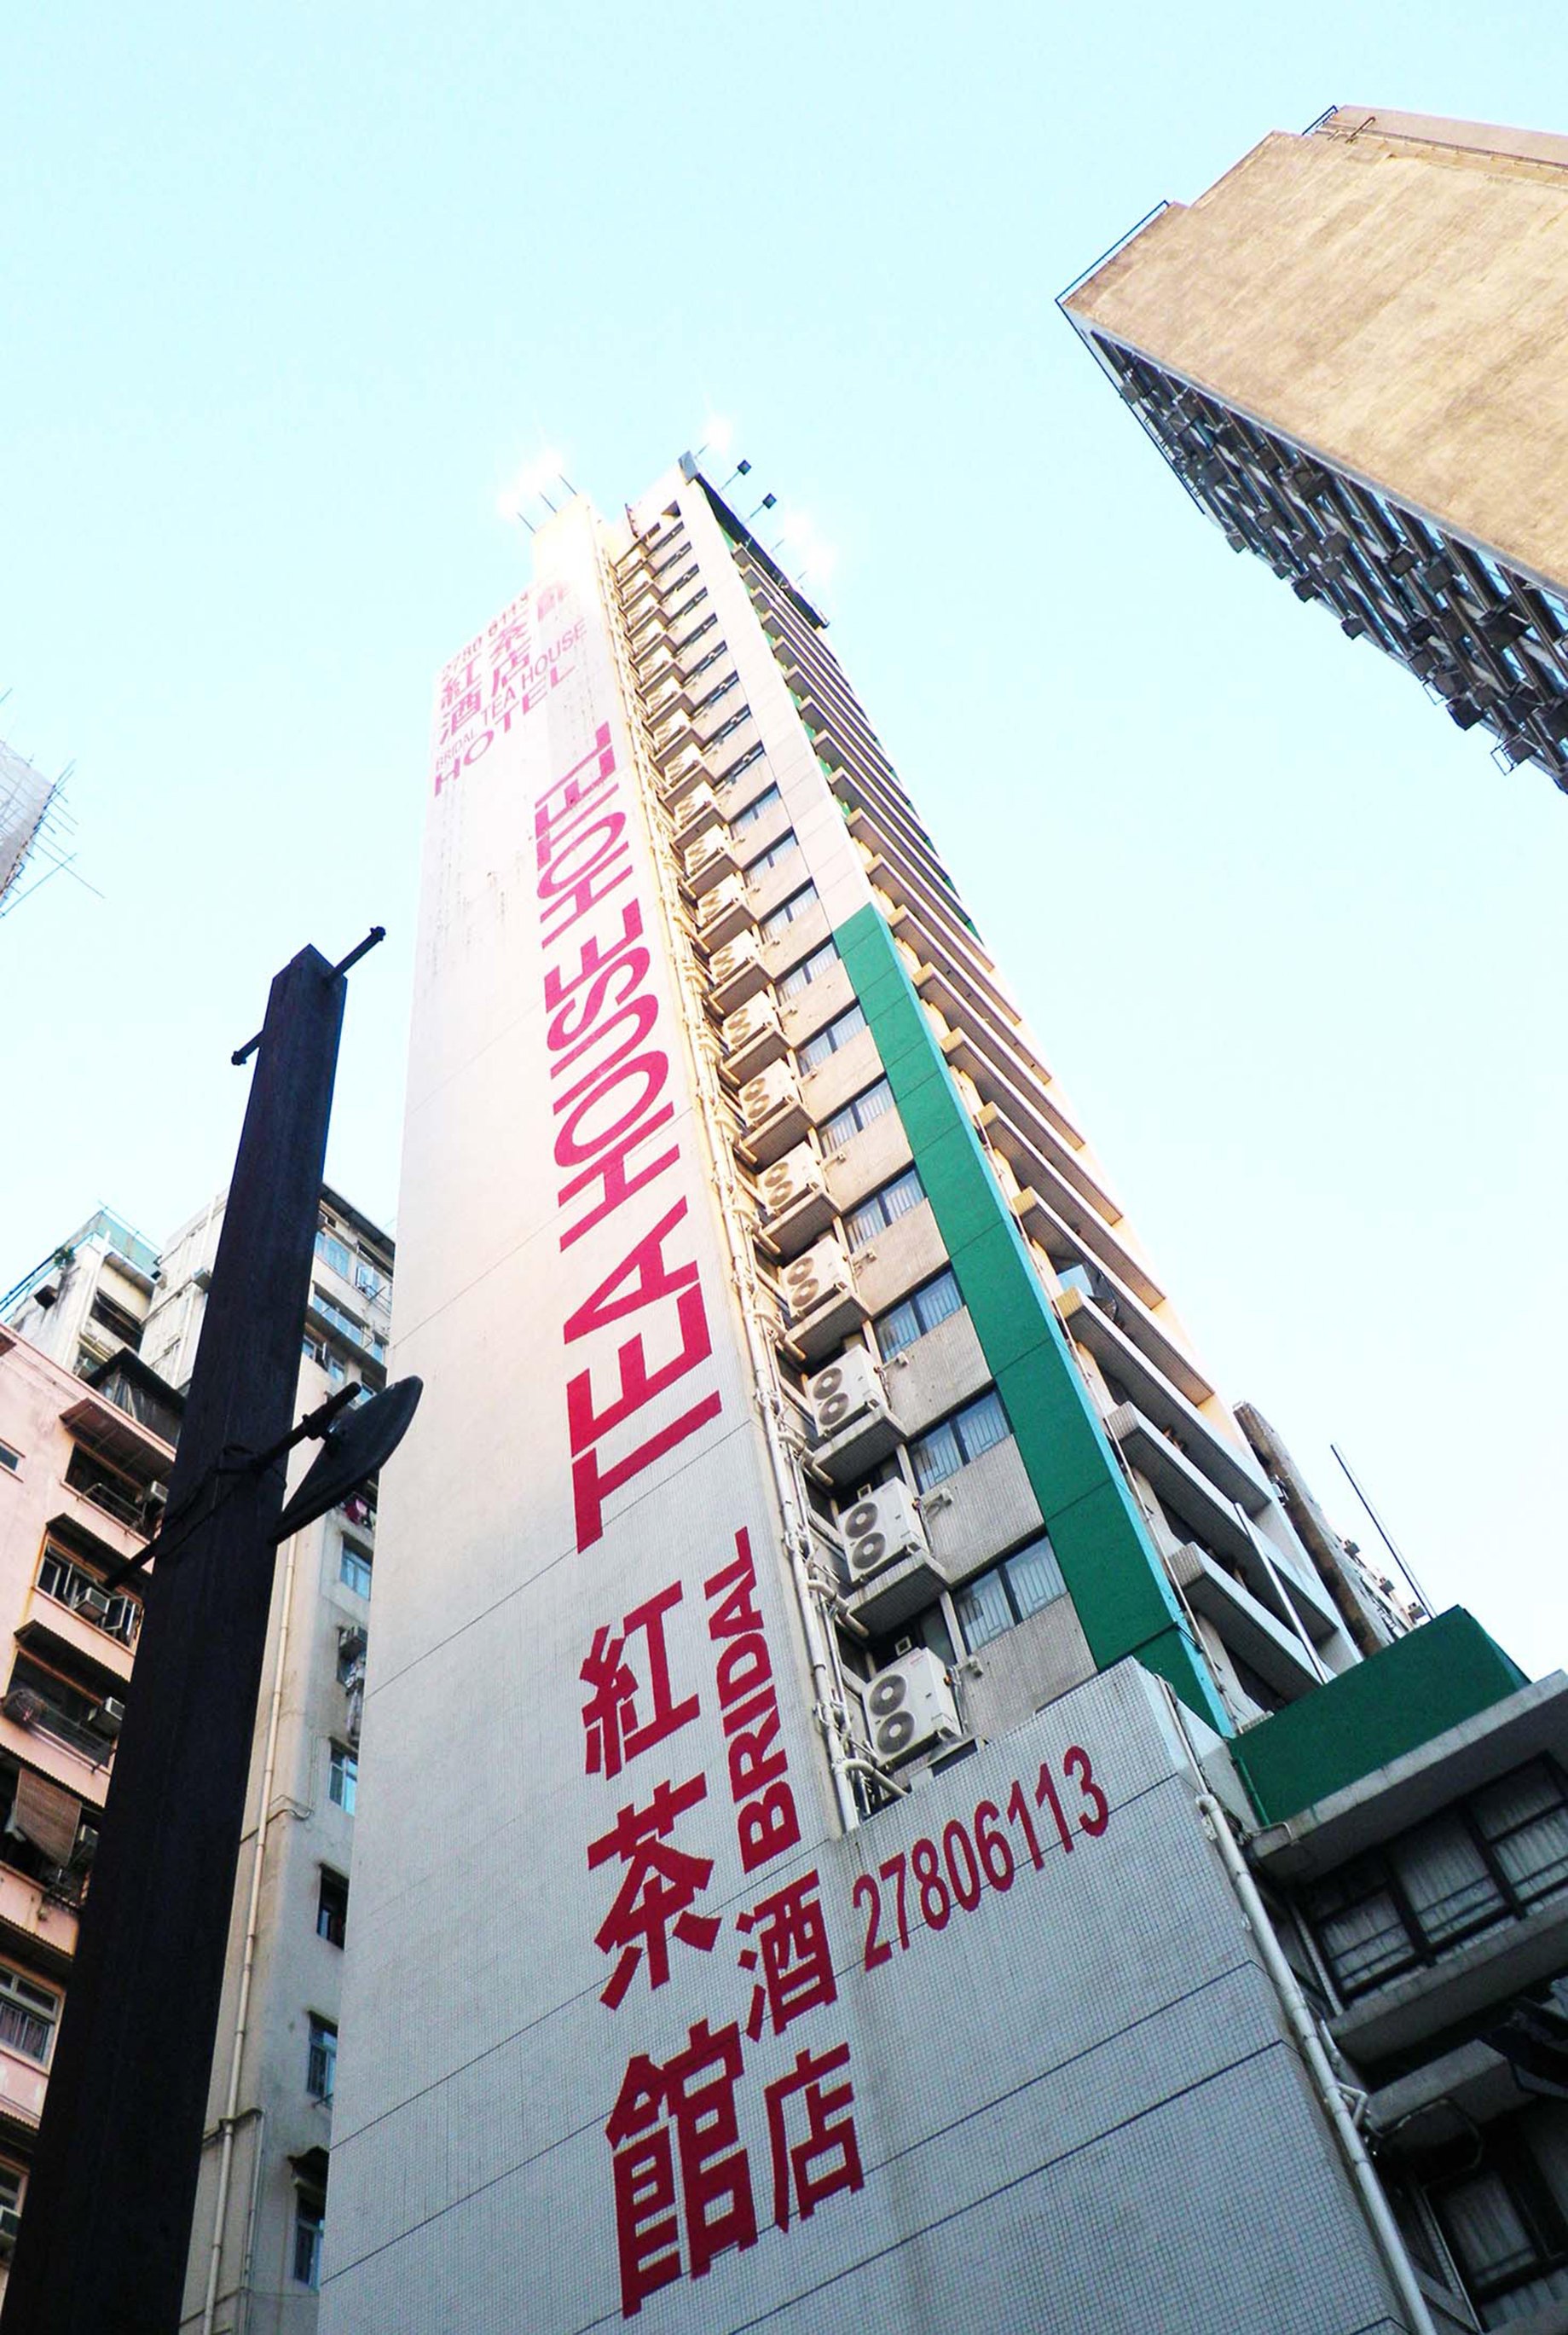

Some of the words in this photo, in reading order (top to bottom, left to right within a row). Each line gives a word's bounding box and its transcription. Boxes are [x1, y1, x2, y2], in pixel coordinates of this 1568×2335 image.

[435, 665, 576, 797] HOTEL
[436, 727, 477, 772] BRIDAL
[481, 685, 516, 726] TEA
[522, 616, 587, 690] HOUSE
[535, 721, 633, 948] HOTEL
[544, 898, 680, 1253] HOUSE
[563, 1195, 723, 1555] TEA
[703, 1526, 801, 1874] BRIDAL
[852, 1746, 1110, 1973] 27806113
[577, 1579, 758, 2319] 紅茶館
[736, 1870, 865, 2232] 酒店
